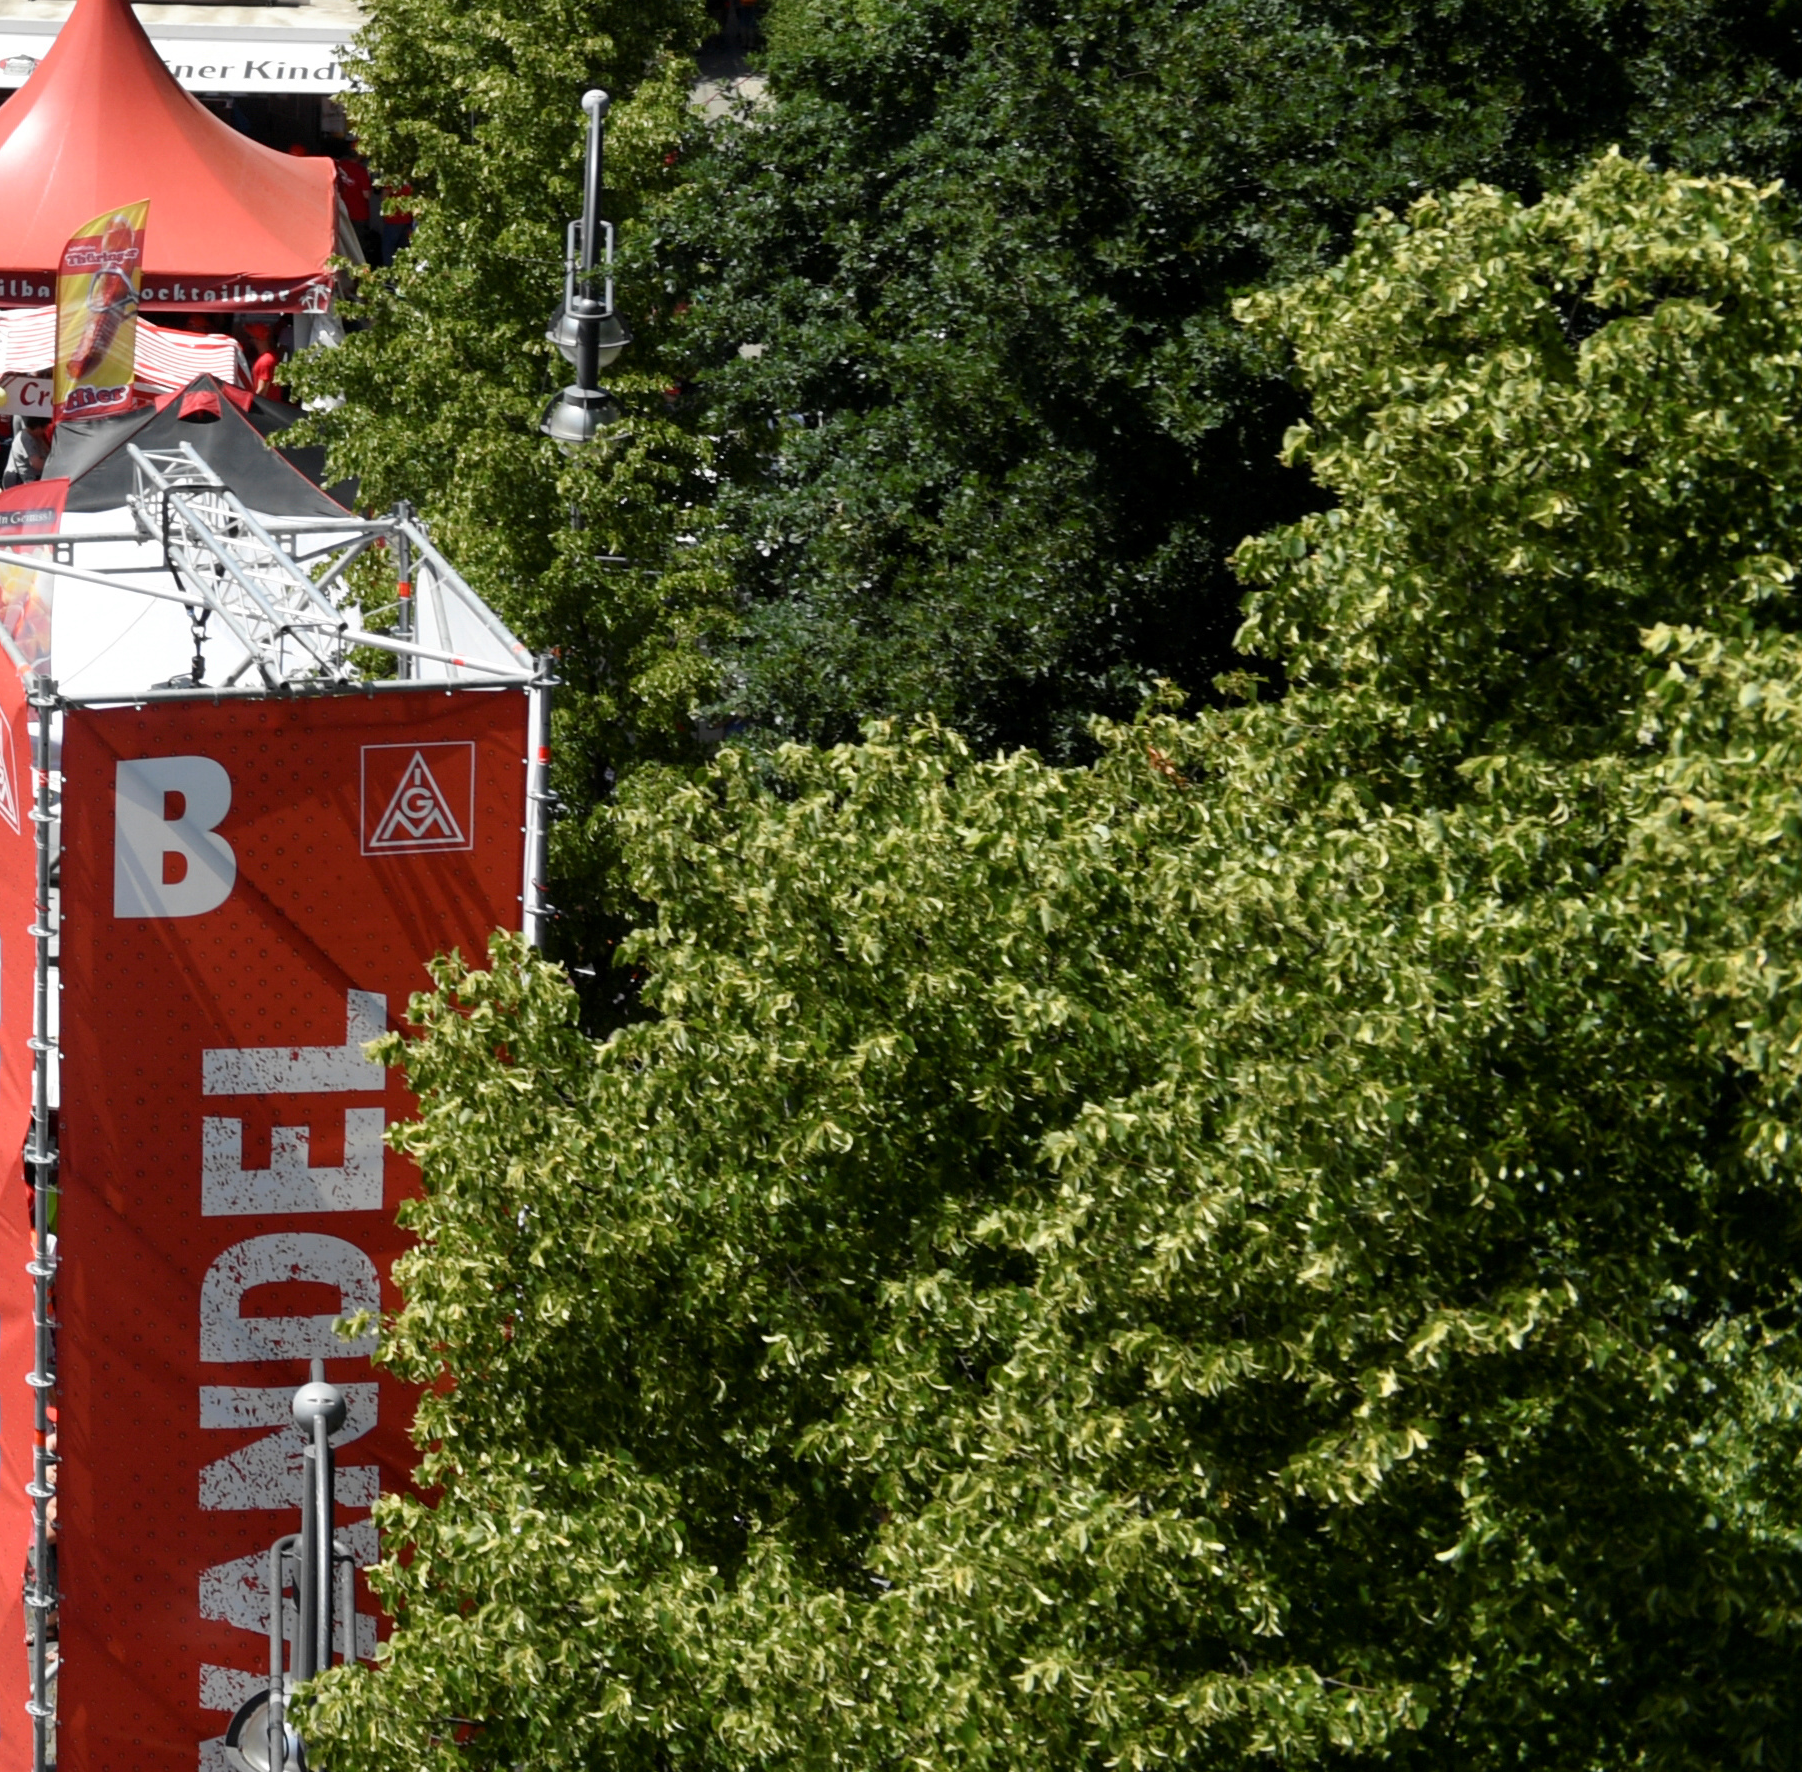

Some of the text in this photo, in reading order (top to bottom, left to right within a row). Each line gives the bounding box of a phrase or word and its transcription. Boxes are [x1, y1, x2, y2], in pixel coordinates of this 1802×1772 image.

[138, 283, 290, 306] ocktailbar
[64, 385, 129, 415] Hier
[113, 755, 237, 918] B
